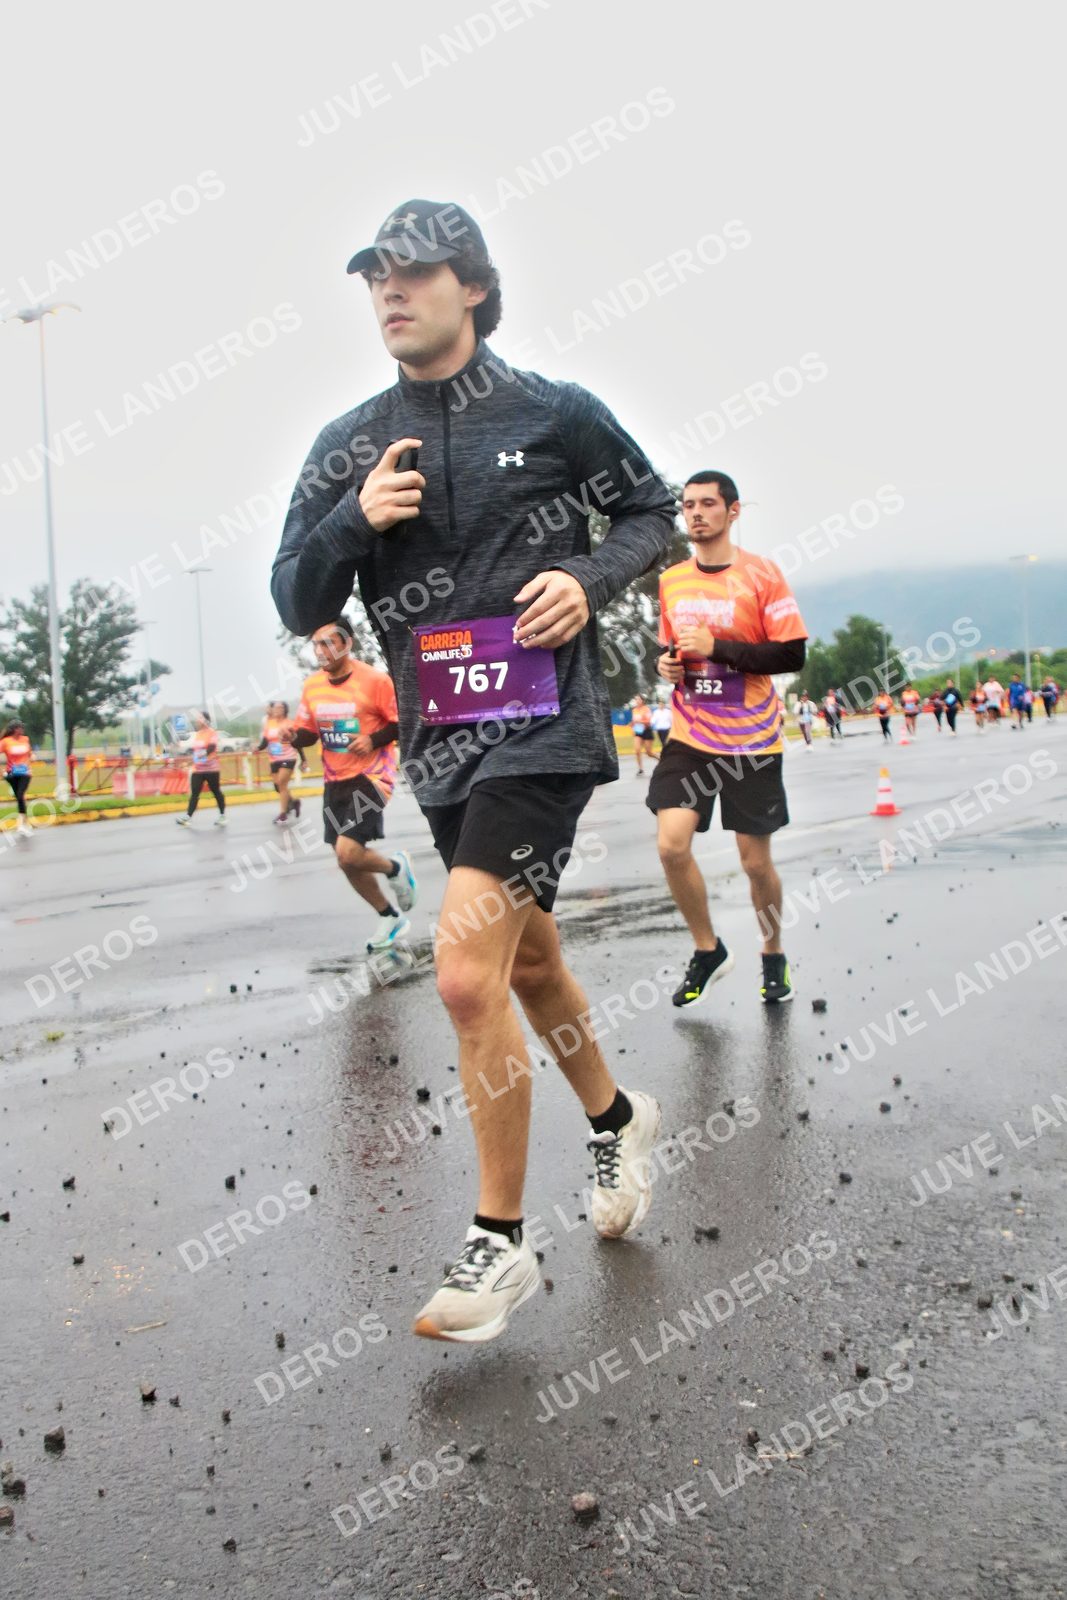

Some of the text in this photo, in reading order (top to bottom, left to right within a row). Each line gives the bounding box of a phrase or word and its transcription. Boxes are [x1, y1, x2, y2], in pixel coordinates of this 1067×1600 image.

[421, 631, 472, 650] CARRERA
[422, 649, 461, 662] OMNILIFE
[449, 662, 508, 694] 767
[695, 680, 722, 694] 552
